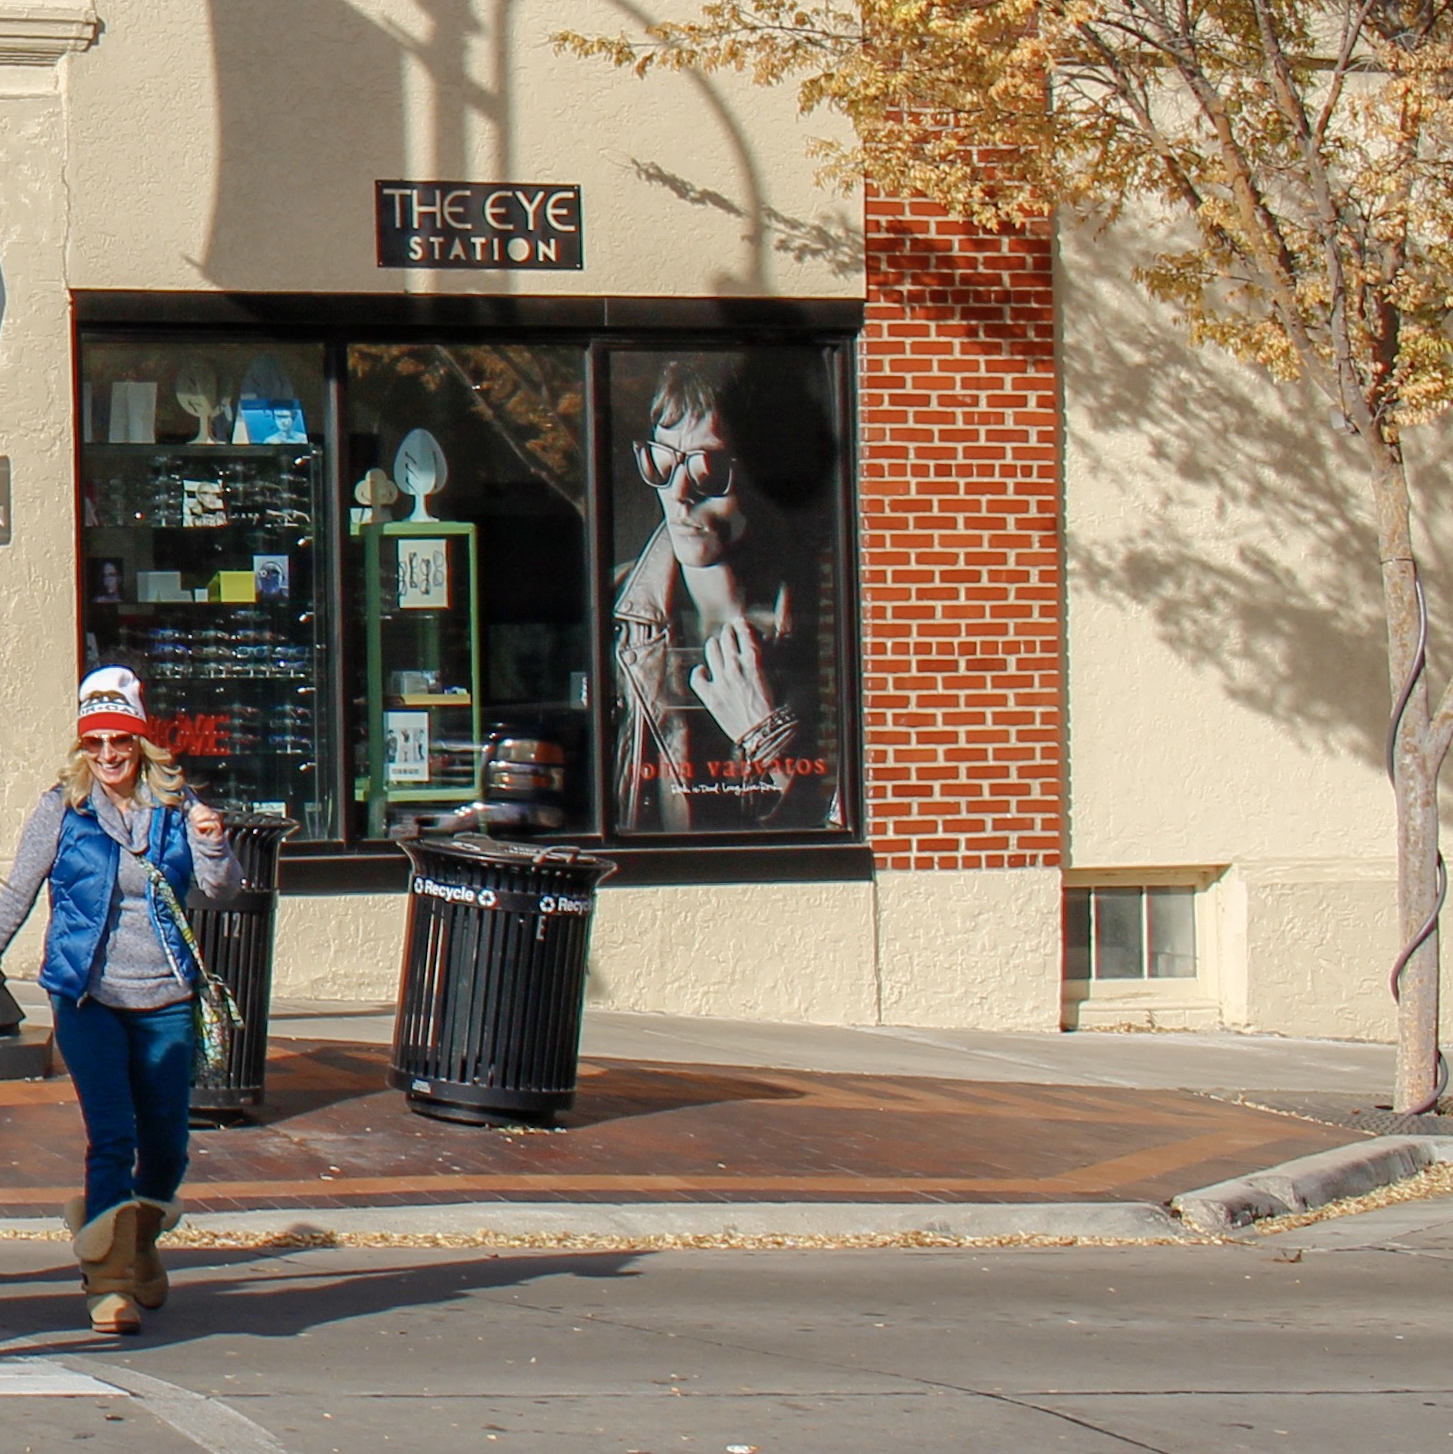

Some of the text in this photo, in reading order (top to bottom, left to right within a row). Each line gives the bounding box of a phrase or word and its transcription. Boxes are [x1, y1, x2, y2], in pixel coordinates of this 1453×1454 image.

[382, 188, 576, 232] THE EYE
[408, 235, 557, 263] STATION
[424, 879, 476, 905] Recycle
